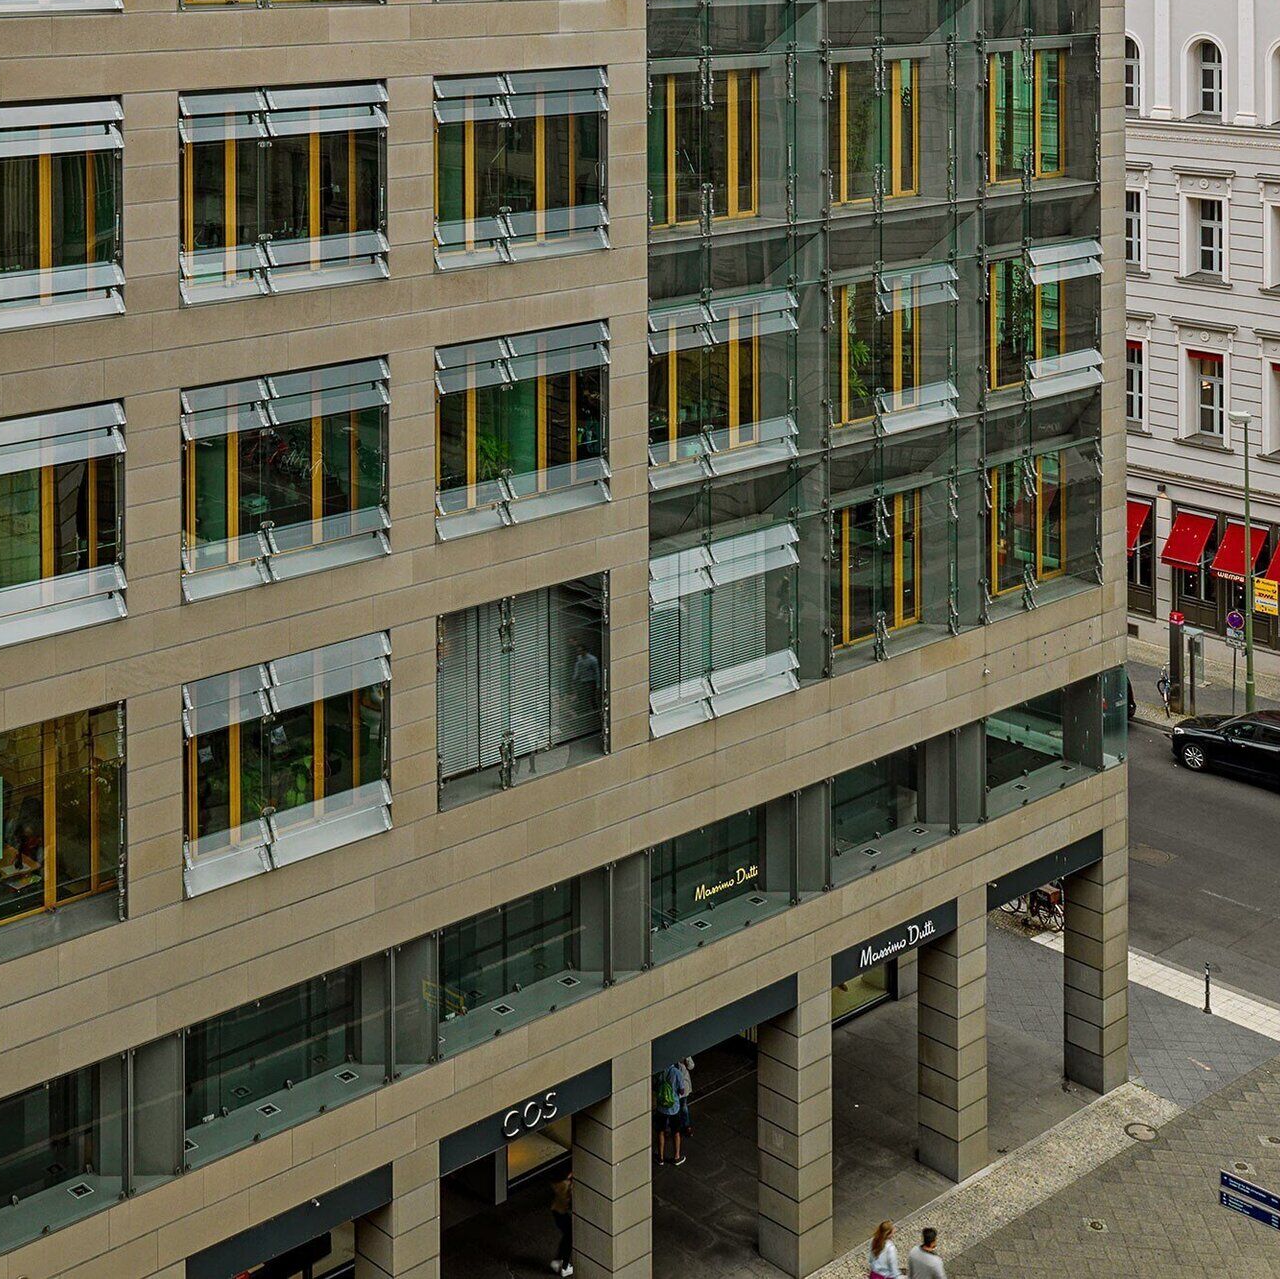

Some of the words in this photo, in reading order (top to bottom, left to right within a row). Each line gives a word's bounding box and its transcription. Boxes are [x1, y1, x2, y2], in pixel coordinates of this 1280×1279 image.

[694, 878, 735, 902] Massimo
[735, 864, 759, 885] Dutti
[860, 938, 907, 968] Massimo
[907, 920, 937, 945] Dutti
[504, 1092, 558, 1137] COS
